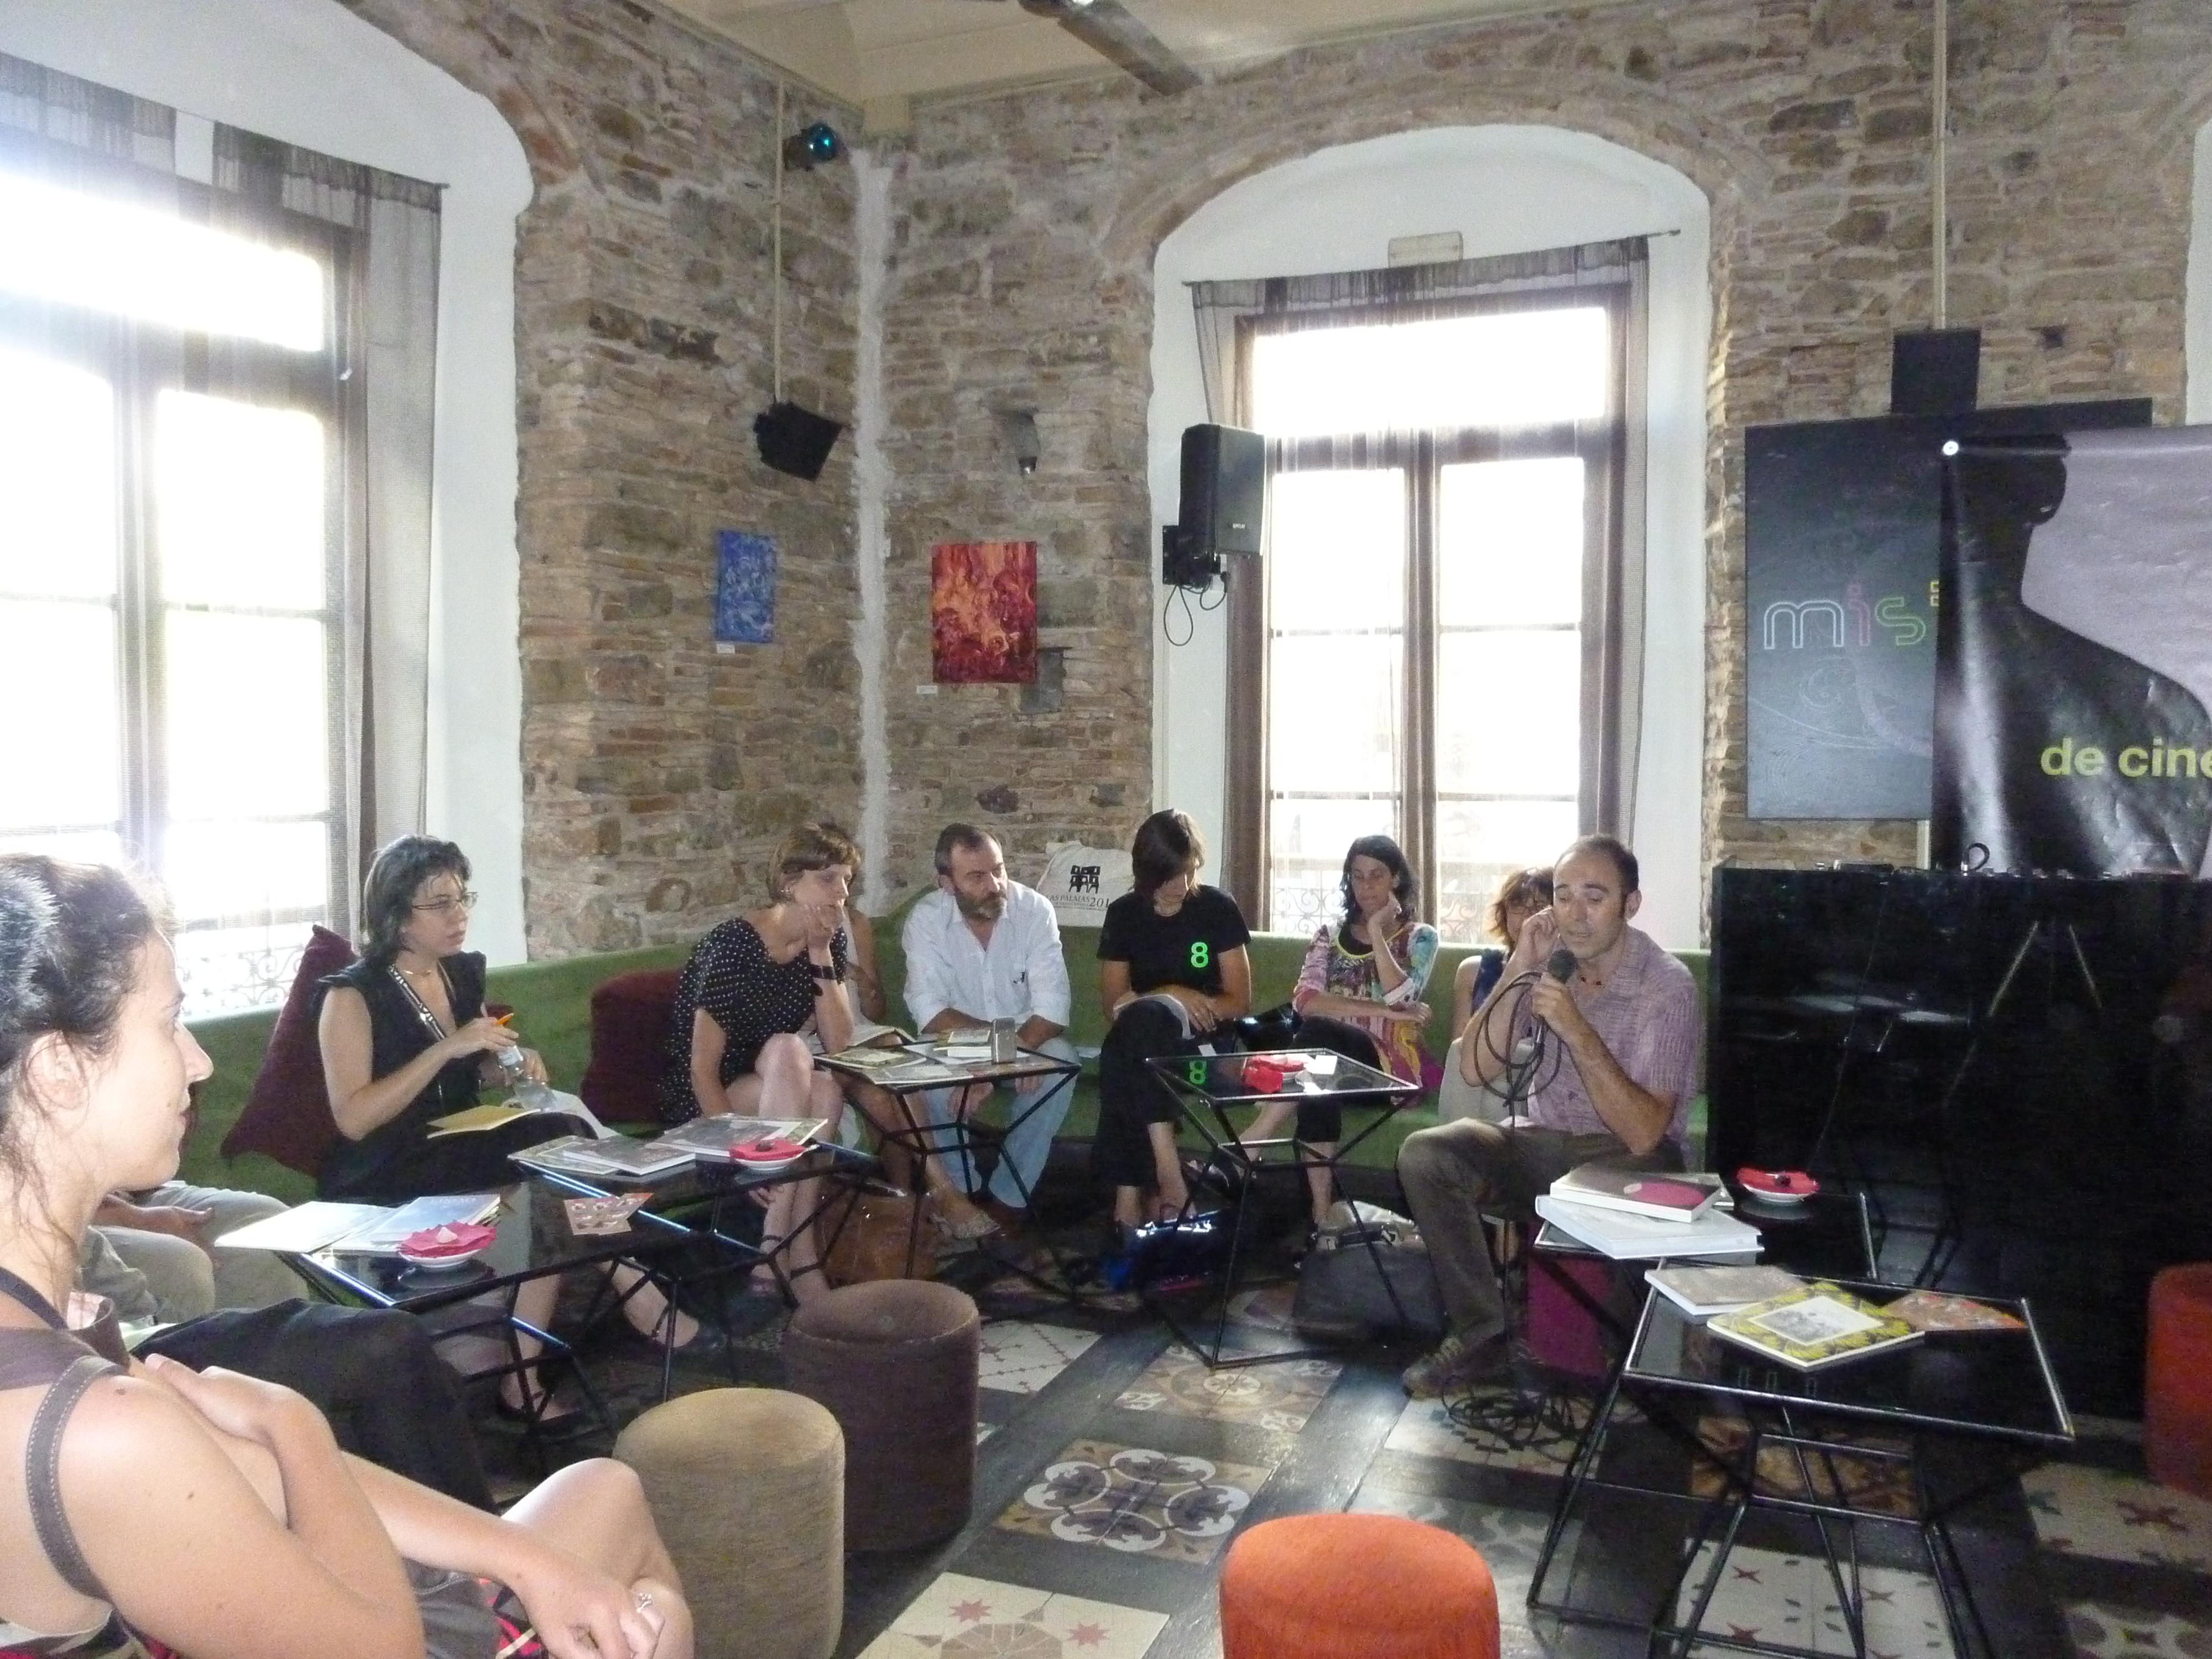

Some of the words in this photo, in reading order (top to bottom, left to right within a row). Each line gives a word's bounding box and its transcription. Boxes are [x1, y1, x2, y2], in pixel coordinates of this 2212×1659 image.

[1764, 582, 1926, 649] mis
[2041, 738, 2105, 776] de
[1191, 942, 1208, 968] 8
